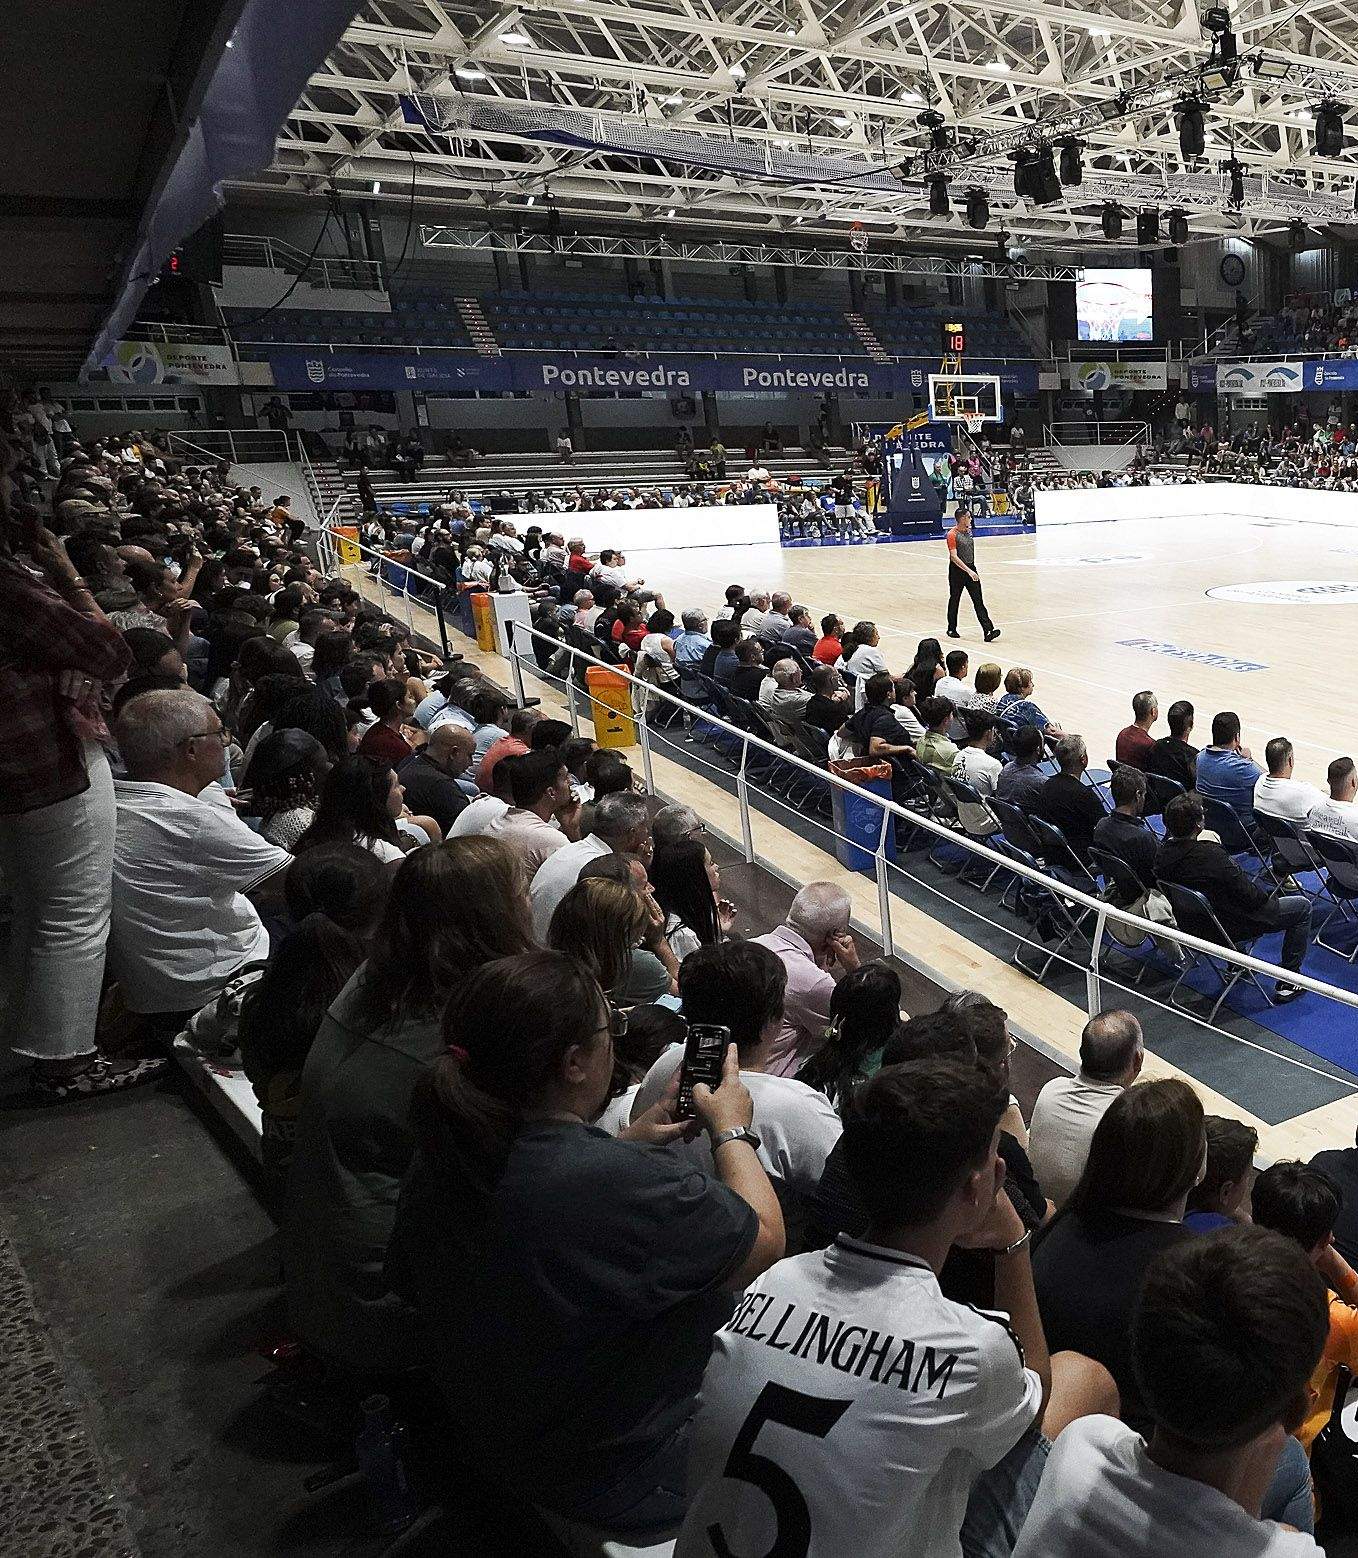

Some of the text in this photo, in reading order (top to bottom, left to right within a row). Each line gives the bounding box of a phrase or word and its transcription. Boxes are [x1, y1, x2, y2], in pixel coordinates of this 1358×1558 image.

[950, 335, 963, 350] 18
[542, 364, 691, 386] Pontevedra
[742, 365, 869, 387] Pontevedra
[724, 1292, 959, 1400] BELLINGHAM
[706, 1380, 854, 1558] 5
